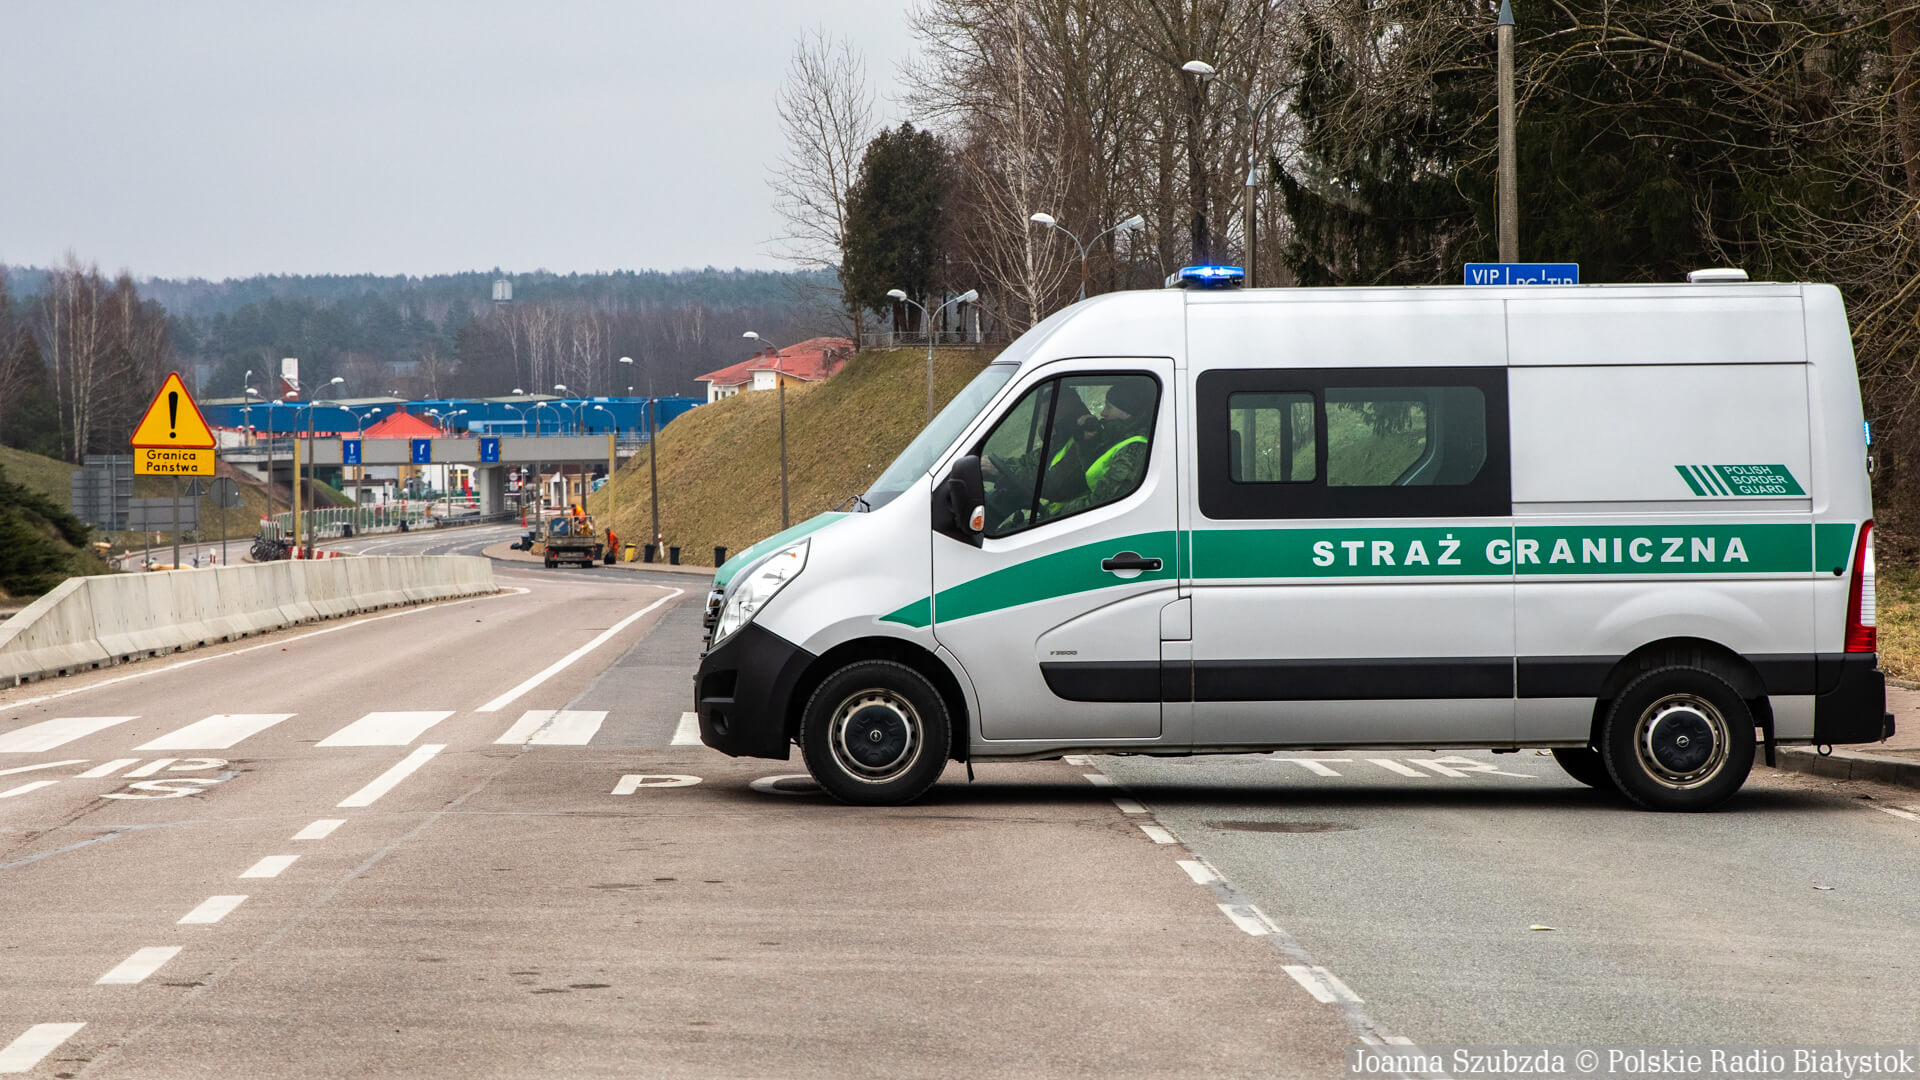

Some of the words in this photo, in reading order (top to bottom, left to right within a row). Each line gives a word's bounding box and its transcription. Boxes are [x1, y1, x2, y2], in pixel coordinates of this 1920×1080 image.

[1472, 269, 1500, 284] VIP
[146, 449, 196, 460] Granica
[146, 461, 198, 472] Państwa
[1723, 466, 1773, 475] POLISH
[1730, 475, 1788, 484] BORDER
[1739, 485, 1787, 494] GUARD
[1312, 533, 1462, 566] STRAŻ
[1486, 537, 1750, 565] GRANICZNA
[1265, 755, 1539, 777] TIR
